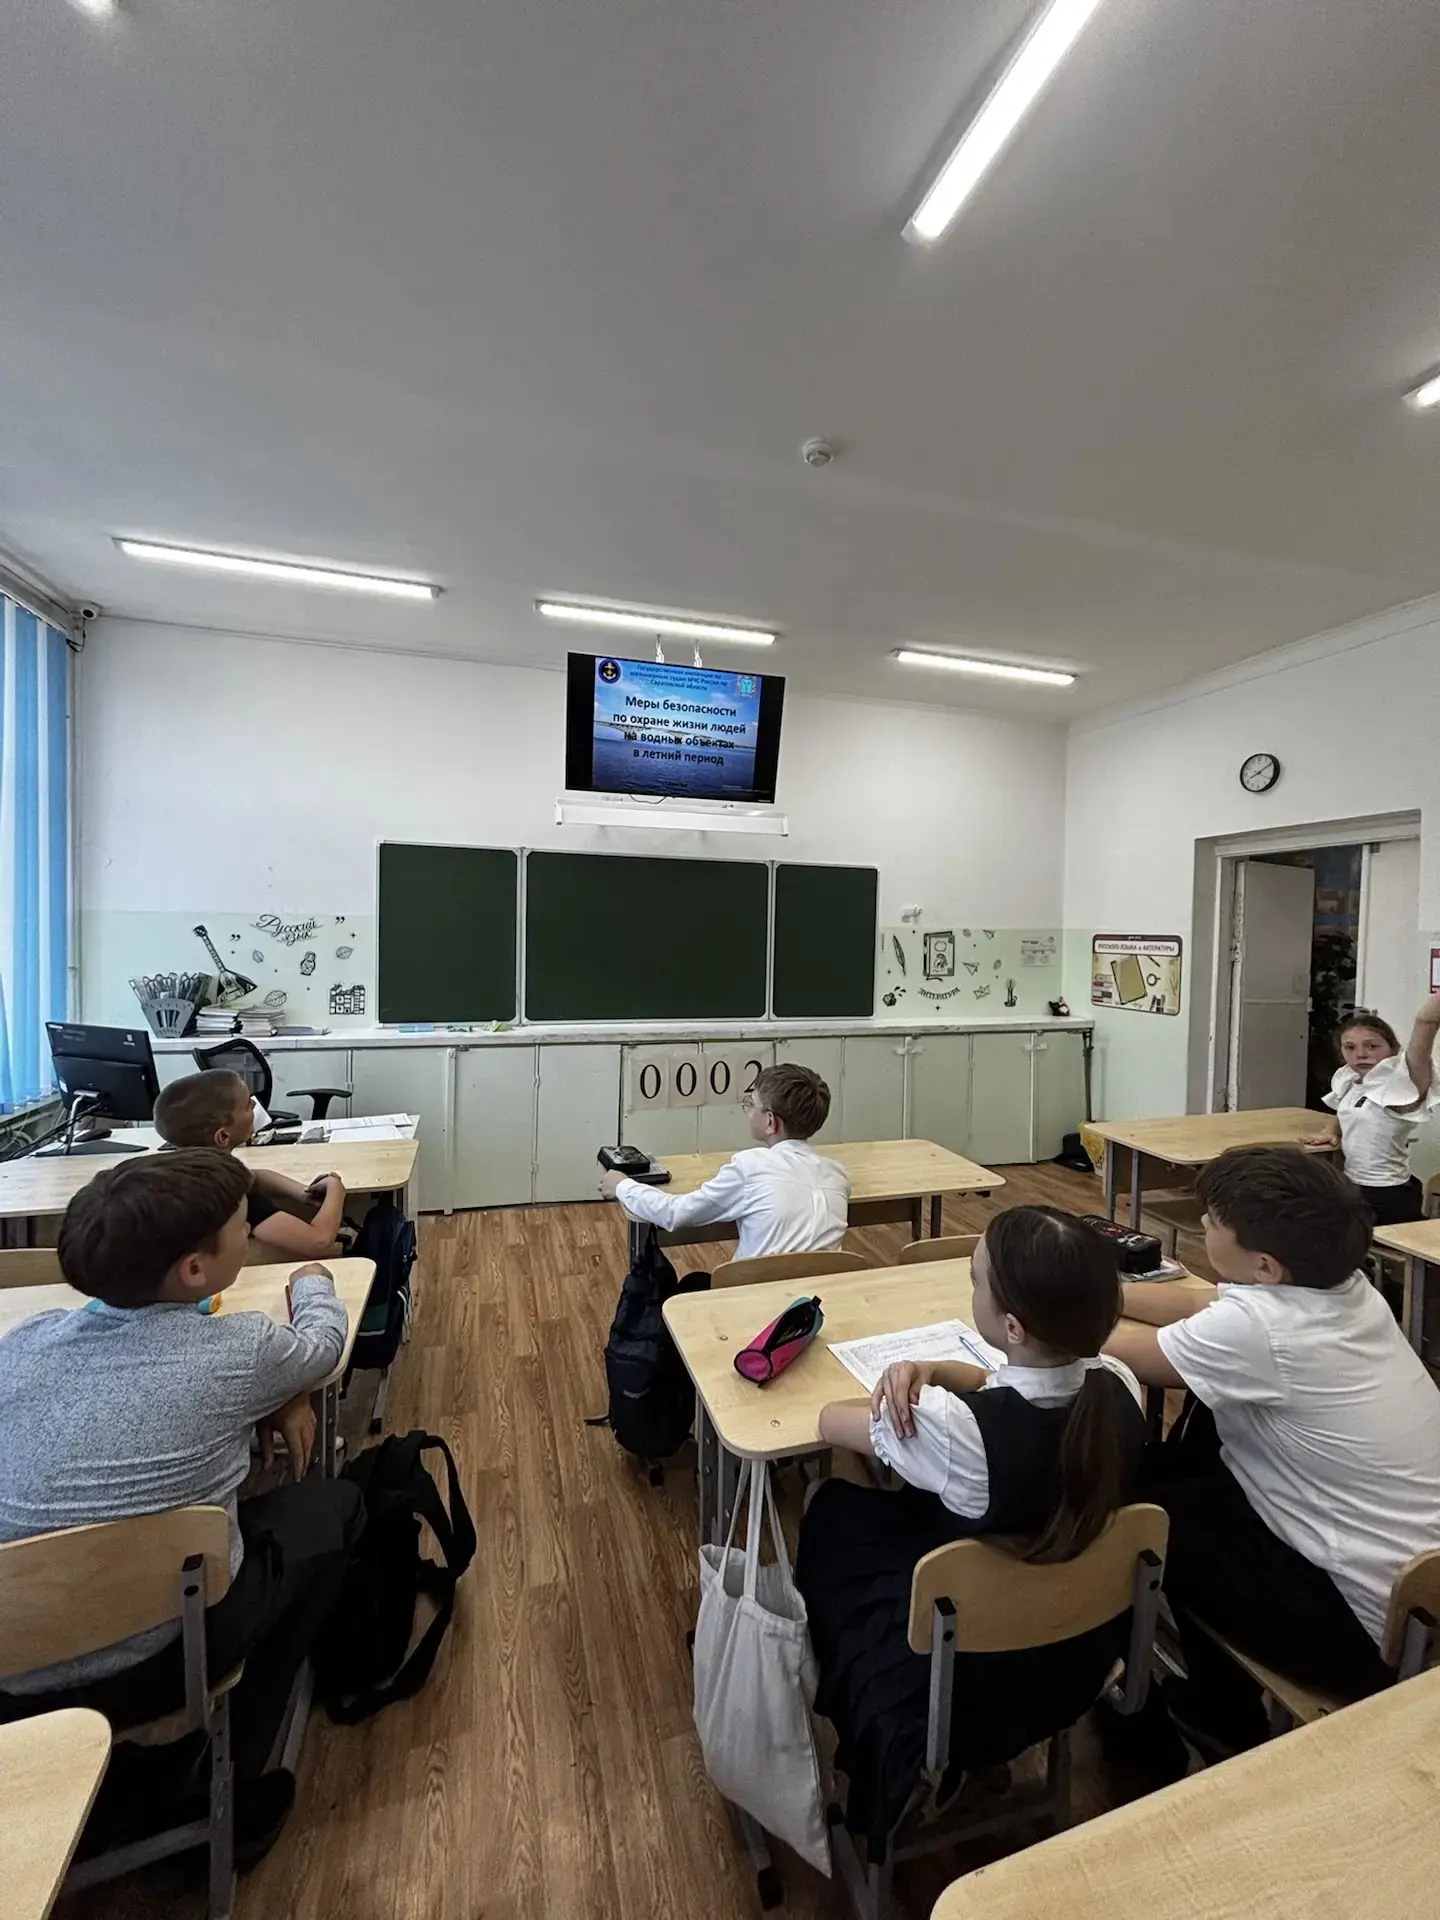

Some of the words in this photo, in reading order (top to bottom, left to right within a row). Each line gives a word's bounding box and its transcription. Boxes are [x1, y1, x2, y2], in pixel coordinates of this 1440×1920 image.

[625, 696, 660, 710] Меры
[662, 699, 737, 717] безопасности
[613, 713, 627, 724] по
[630, 715, 670, 729] охране
[672, 718, 708, 732] жизни
[710, 722, 746, 735] людей
[624, 732, 637, 742] на
[640, 733, 683, 746] водных
[685, 736, 735, 750] объектах
[633, 750, 640, 758] в
[641, 748, 682, 762] летний
[684, 753, 724, 767] период
[256, 914, 317, 938] Русский
[281, 930, 312, 947] язык
